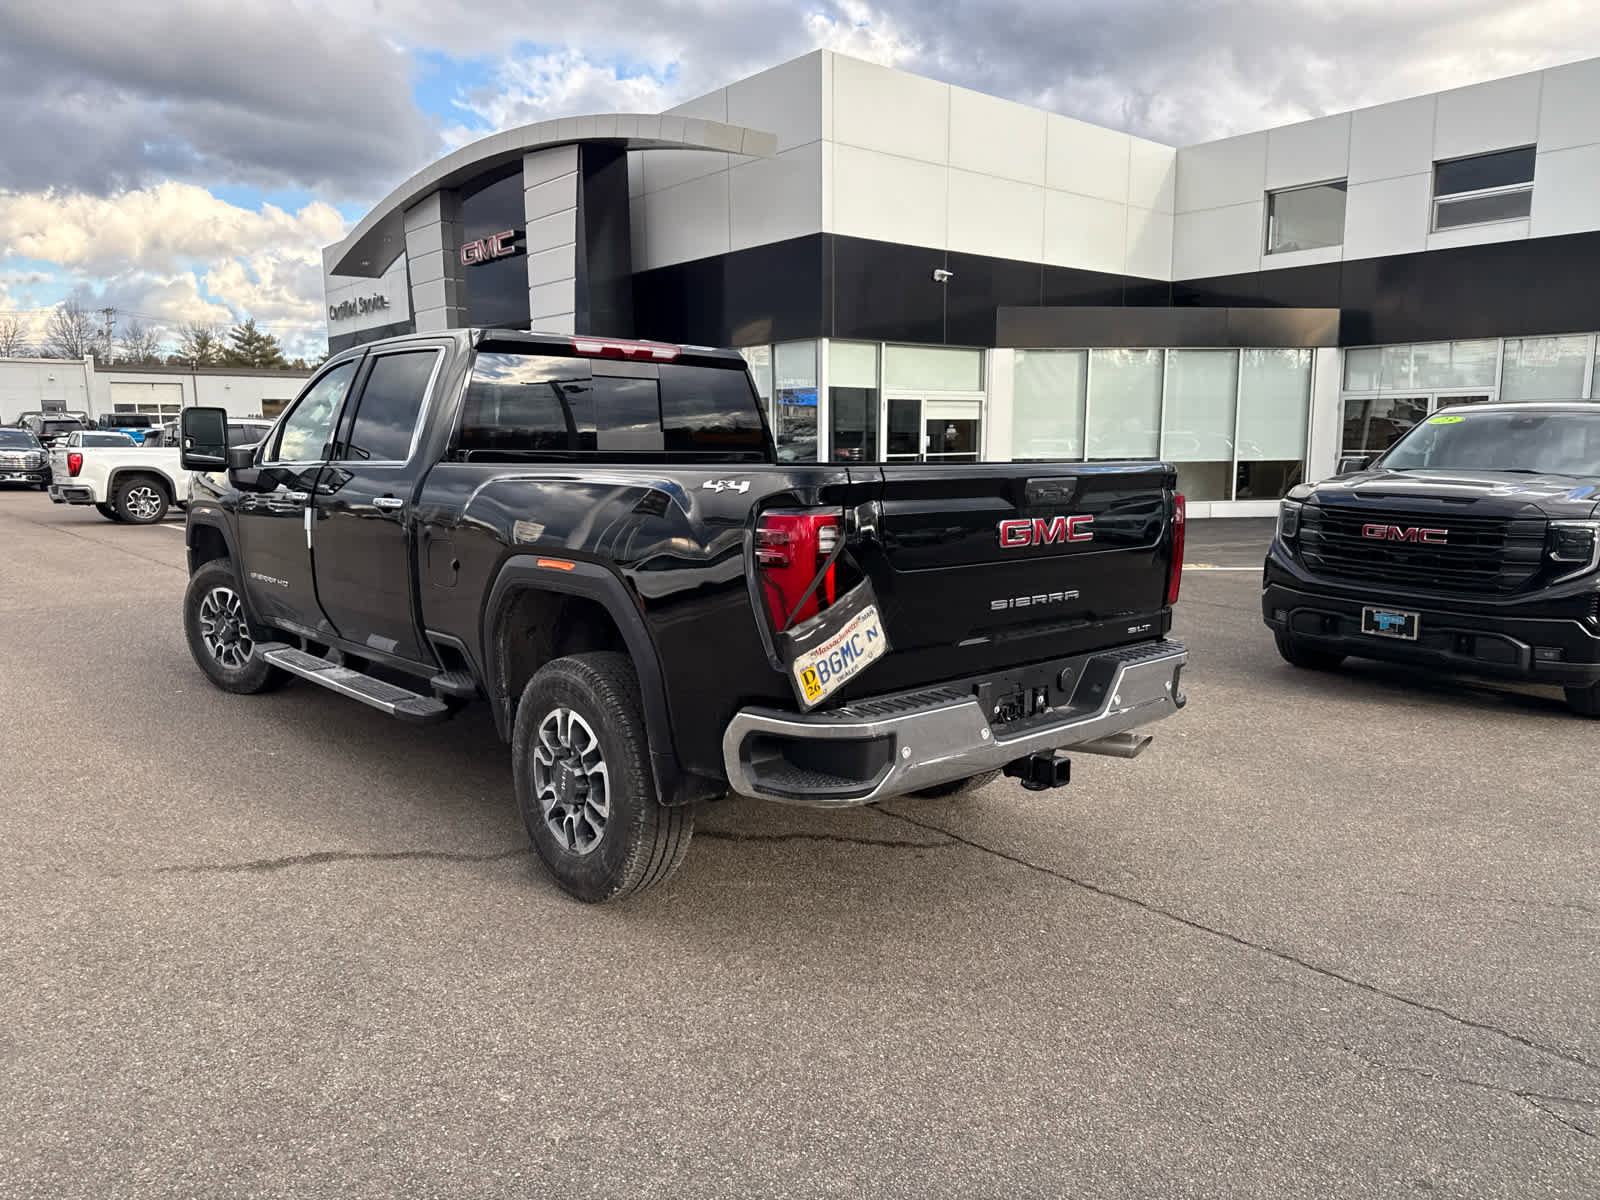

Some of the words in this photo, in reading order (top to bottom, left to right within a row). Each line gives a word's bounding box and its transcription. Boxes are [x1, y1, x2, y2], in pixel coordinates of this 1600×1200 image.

[460, 229, 515, 265] GMC
[999, 514, 1094, 549] GMC
[1361, 523, 1448, 545] GMC
[990, 589, 1080, 610] SIERRA
[1127, 624, 1151, 634] SLT
[816, 633, 864, 685] BGMC
[865, 625, 879, 642] N
[803, 669, 816, 685] D
[837, 663, 859, 683] DEALER
[807, 682, 821, 697] 26
